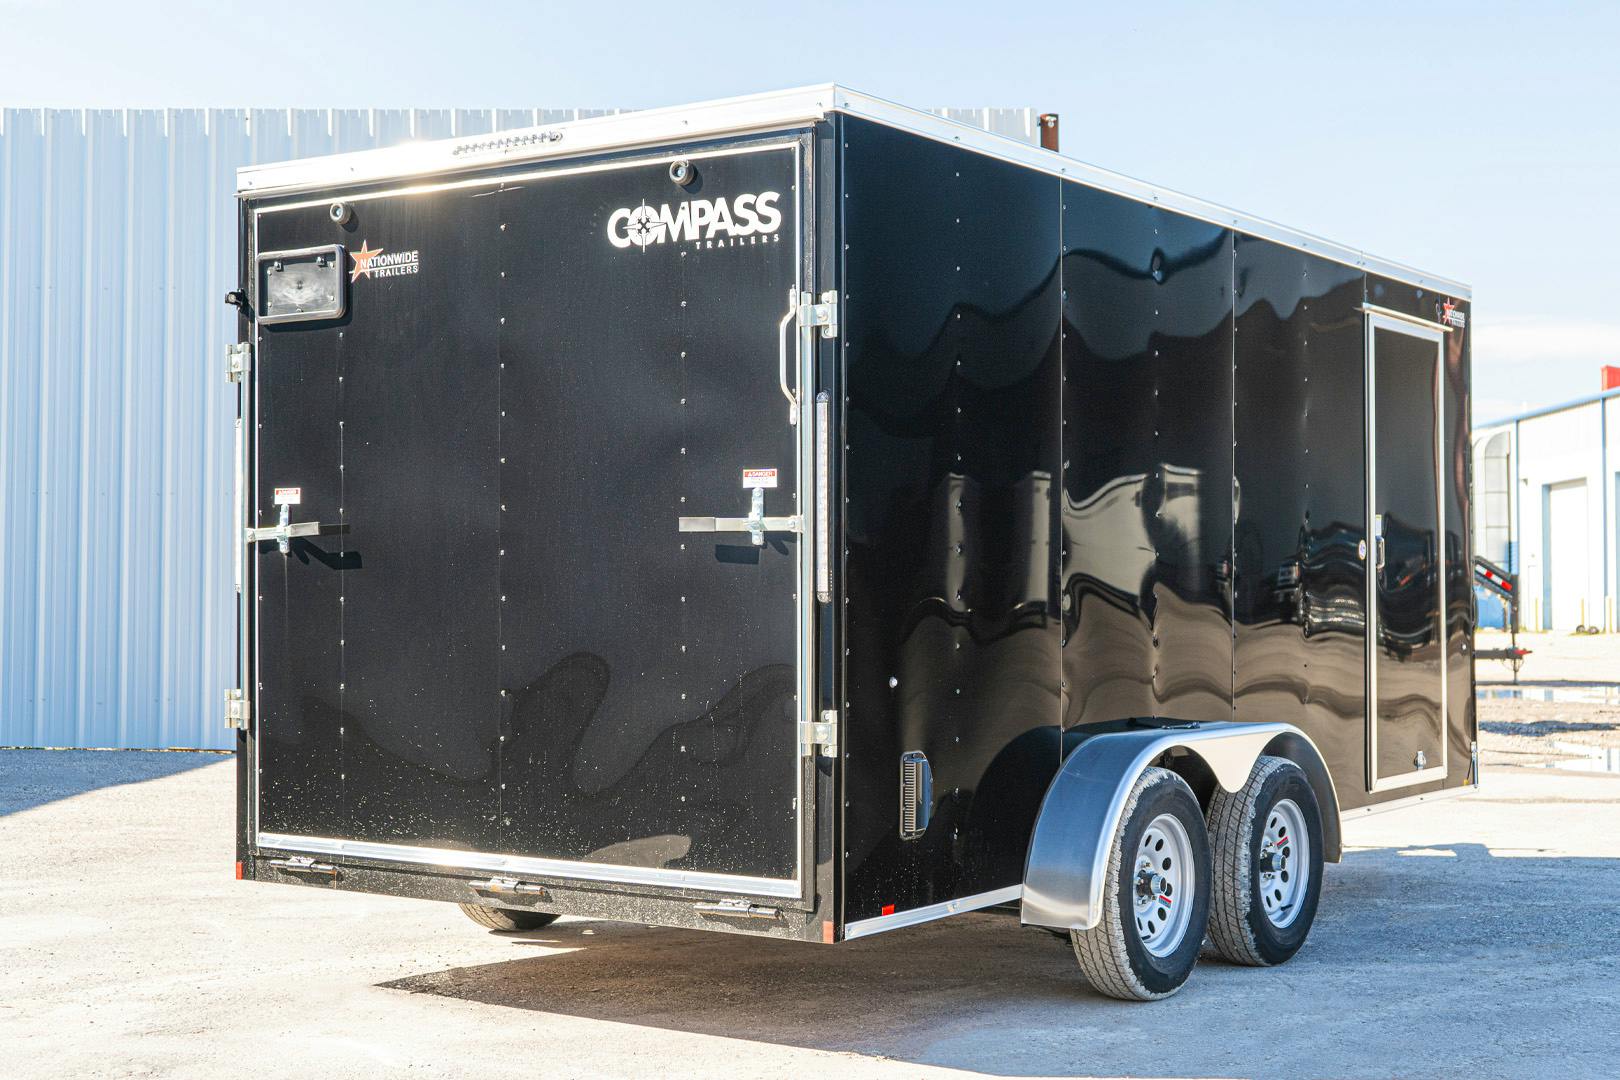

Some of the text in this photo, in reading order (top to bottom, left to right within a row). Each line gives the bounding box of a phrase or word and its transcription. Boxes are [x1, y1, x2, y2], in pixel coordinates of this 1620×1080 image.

[607, 191, 782, 248] COMPASS
[695, 233, 780, 249] TRAILERS
[360, 250, 418, 269] NATIONWIDE
[374, 265, 418, 278] TRAILERS
